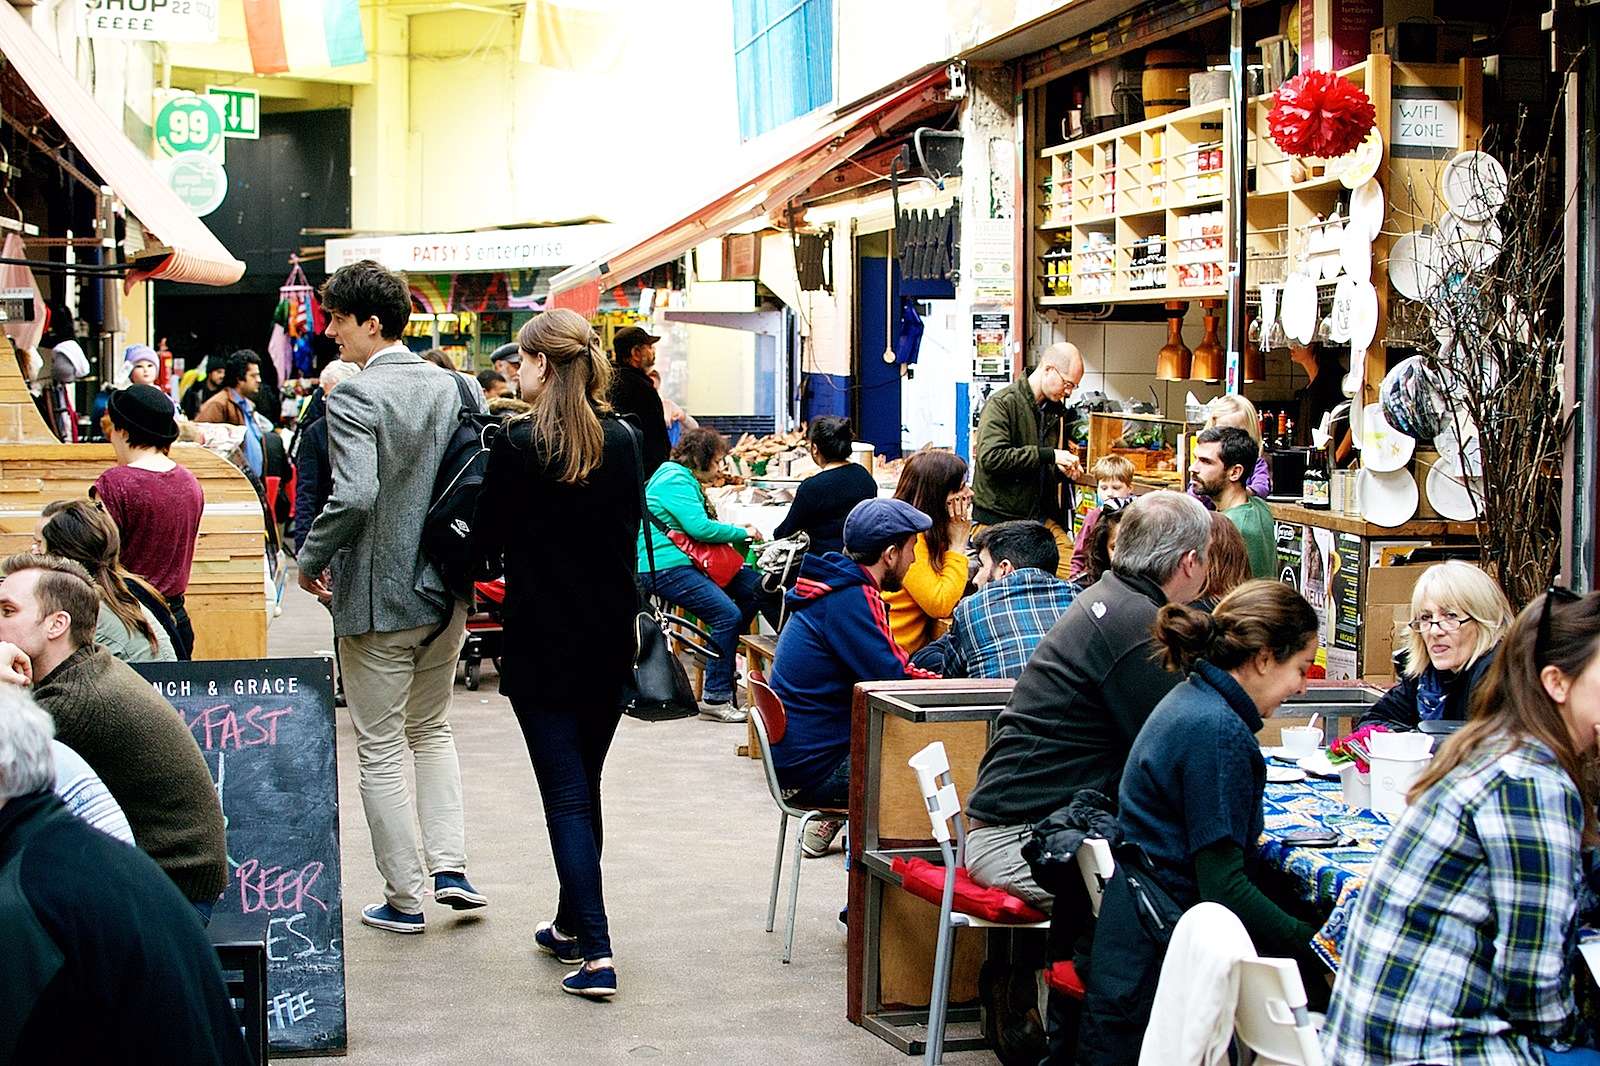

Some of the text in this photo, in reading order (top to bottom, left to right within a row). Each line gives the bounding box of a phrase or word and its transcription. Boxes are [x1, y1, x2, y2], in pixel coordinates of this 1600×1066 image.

[172, 1, 191, 14] 22
[1399, 104, 1438, 120] WIFI
[168, 109, 209, 145] 99
[1401, 123, 1446, 138] ZONE
[412, 245, 458, 263] PATSY
[207, 680, 218, 696] &
[234, 677, 299, 695] GRACE
[179, 703, 294, 751] FAST
[236, 858, 328, 914] BEER
